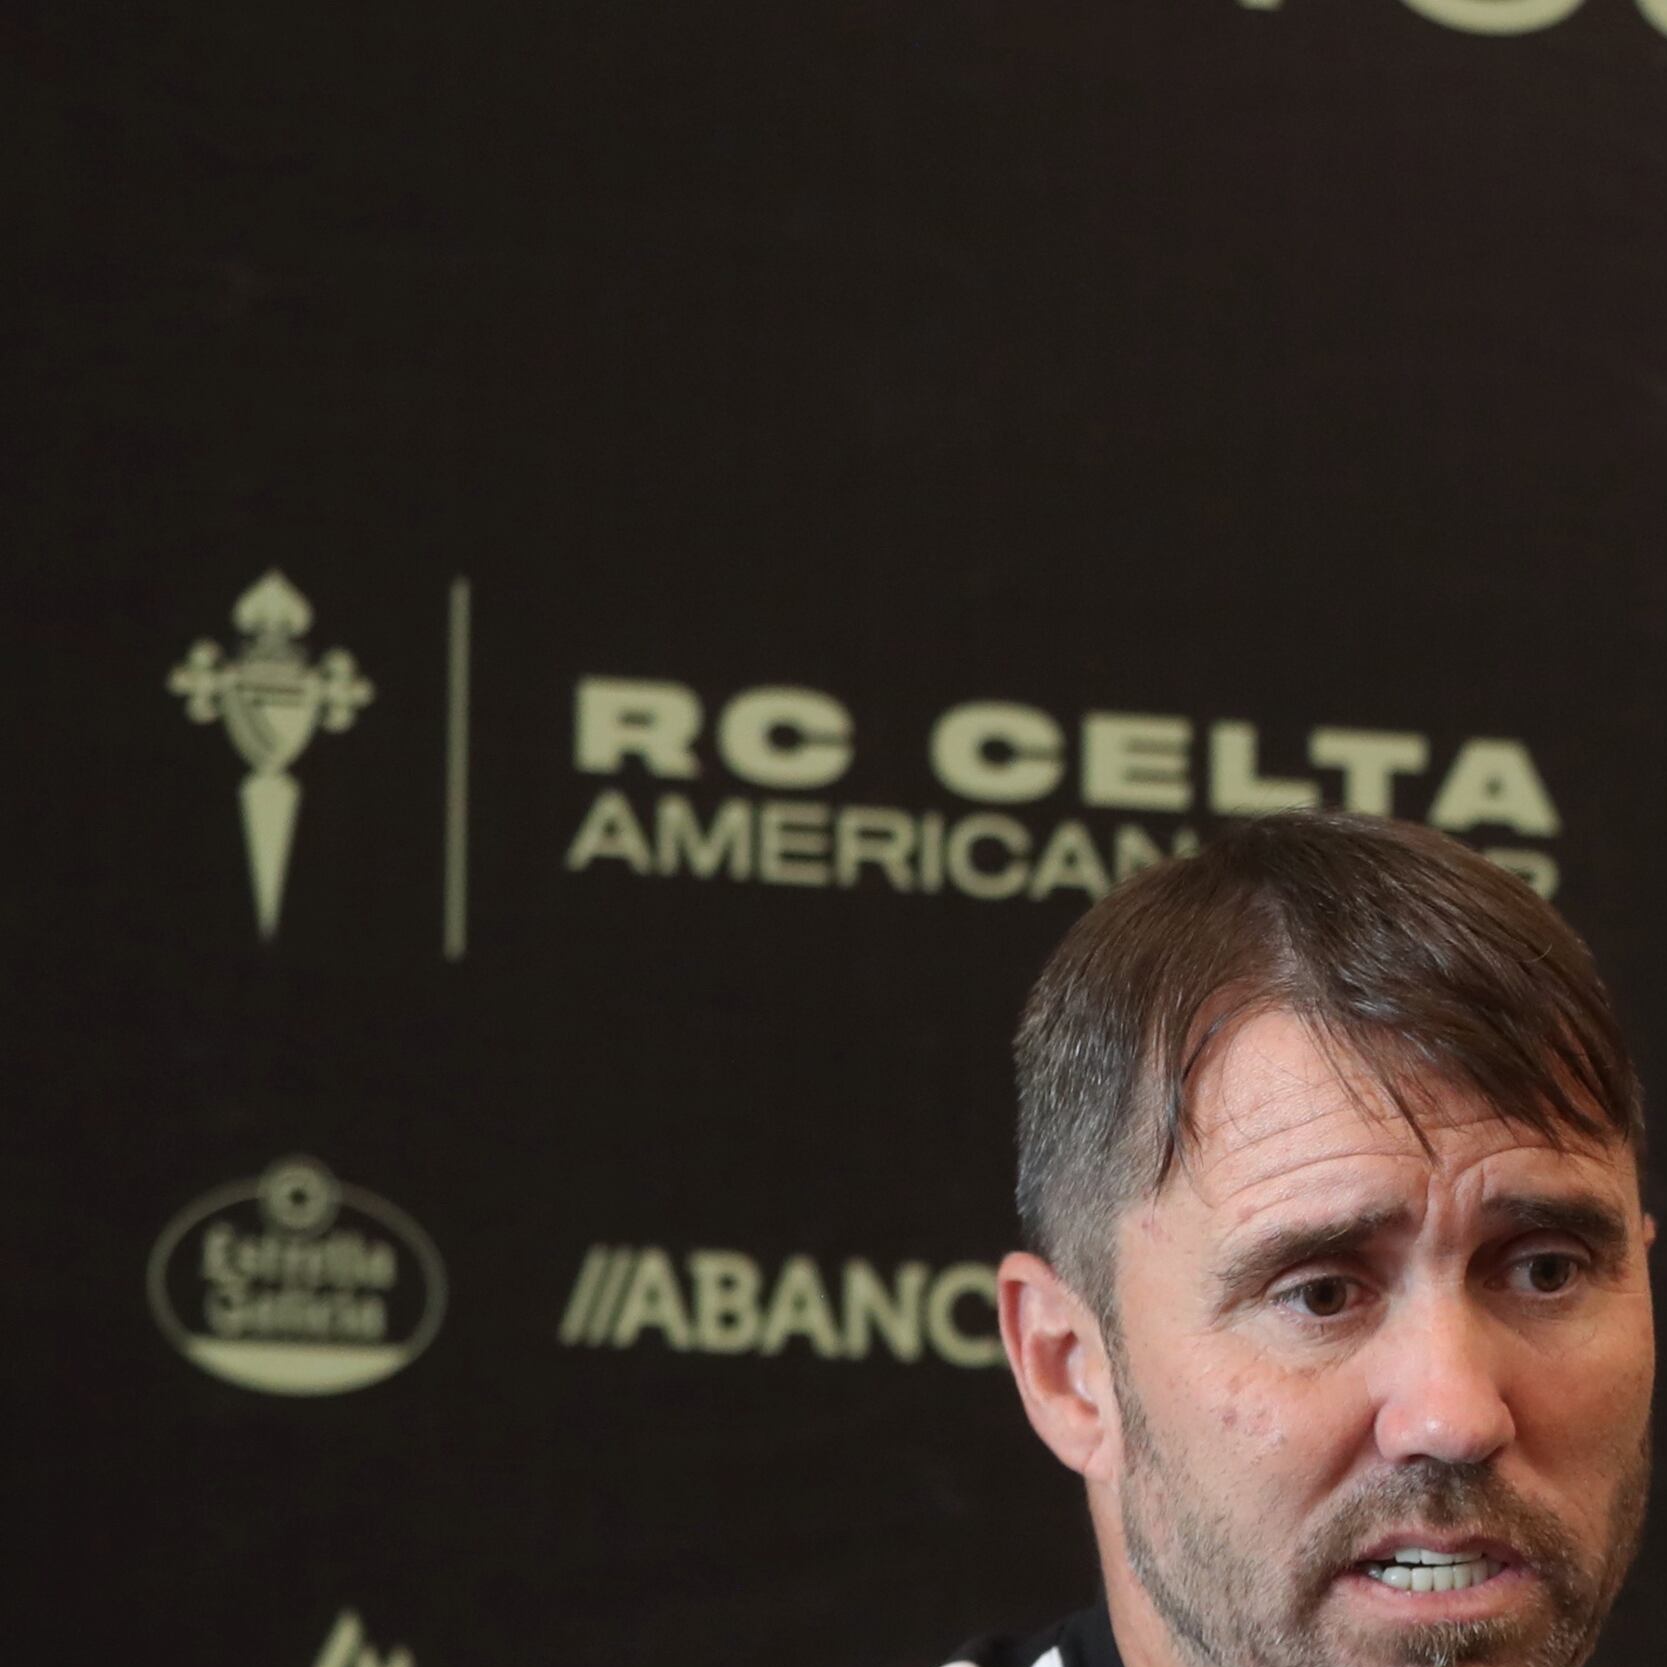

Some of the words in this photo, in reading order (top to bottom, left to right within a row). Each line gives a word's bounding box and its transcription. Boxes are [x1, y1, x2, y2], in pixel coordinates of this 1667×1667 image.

[574, 677, 856, 788] RC
[930, 700, 1561, 838] CELTA
[612, 1247, 1003, 1369] ABANC
